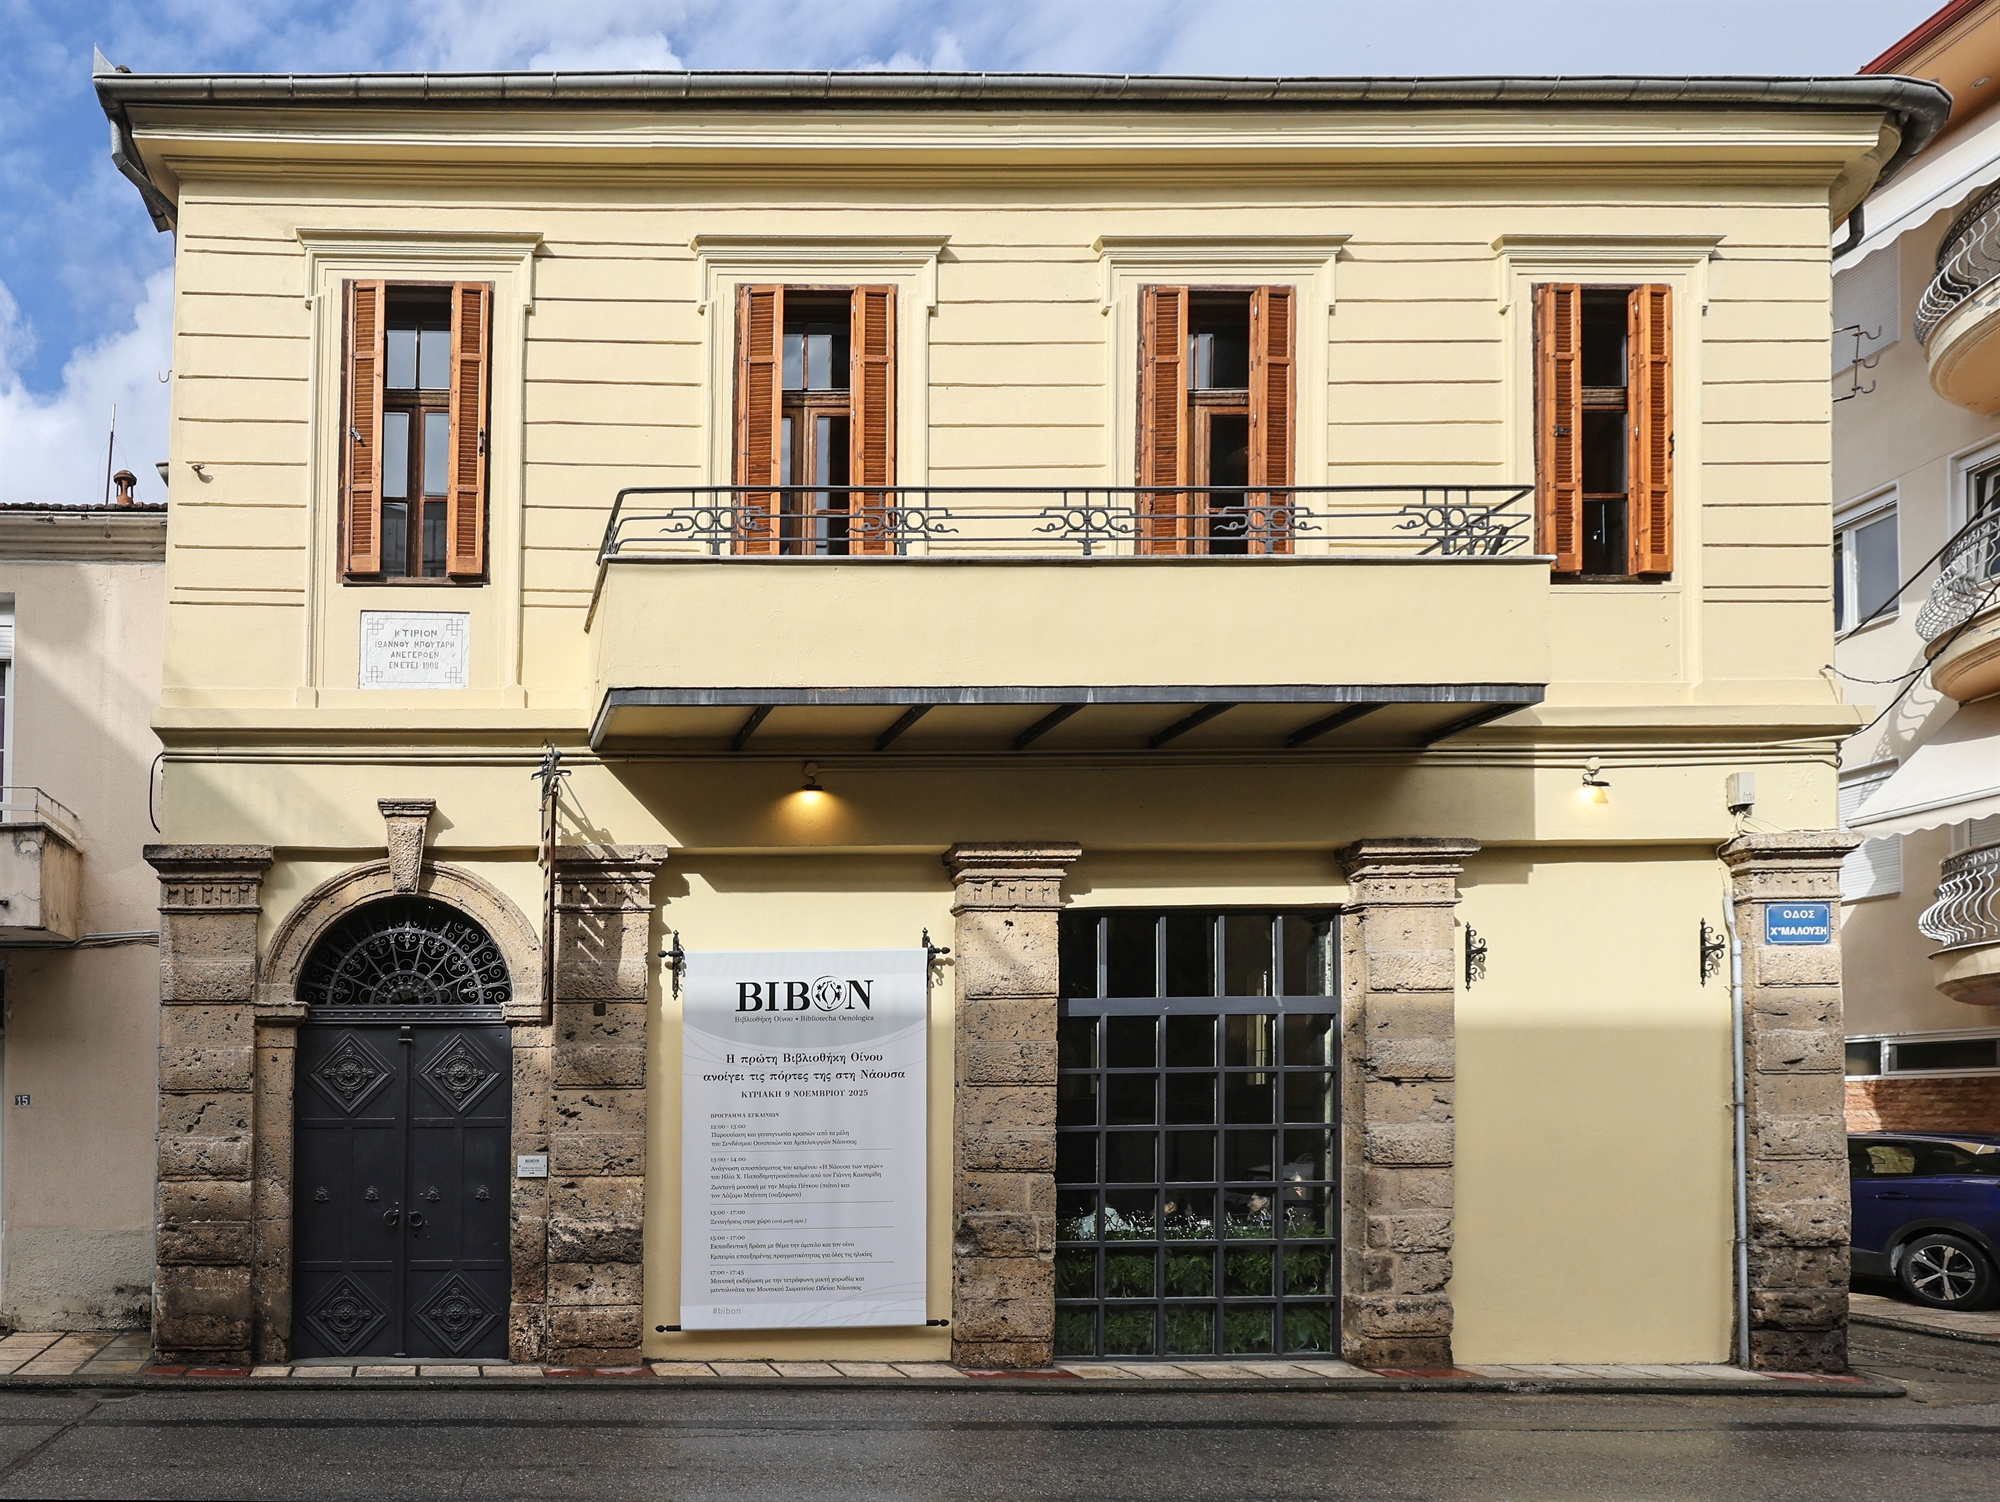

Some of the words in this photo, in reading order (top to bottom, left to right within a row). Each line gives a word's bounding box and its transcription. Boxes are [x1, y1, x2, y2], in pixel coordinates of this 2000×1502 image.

[394, 629, 438, 638] ΚΤΙΡΙΟΝ
[374, 640, 409, 648] ΙΩΑΝΝΟΥ
[422, 662, 439, 670] 1908
[1783, 910, 1815, 919] ΟΔΟΣ
[735, 975, 874, 1012] BIBON
[726, 1054, 735, 1064] Η
[740, 1052, 778, 1066] πρώτη
[782, 1052, 846, 1066] Βιβλιοθήκη
[850, 1052, 884, 1062] Οίνου
[703, 1071, 745, 1083] ανοίγει
[749, 1073, 765, 1083] τις
[769, 1070, 809, 1082] πόρτες
[813, 1072, 832, 1082] της
[835, 1072, 856, 1082] στη
[860, 1069, 906, 1079] Νάουσα
[741, 1090, 782, 1099] ΚΥΡΙΑΚΗ
[784, 1090, 790, 1098] 9
[793, 1090, 846, 1098] ΝΟΕΜΒΡΙΟΥ
[848, 1089, 869, 1097] 2025
[16, 1096, 28, 1106] 15
[832, 1138, 858, 1146] Νάουσας
[836, 1284, 862, 1292] Νάουσας
